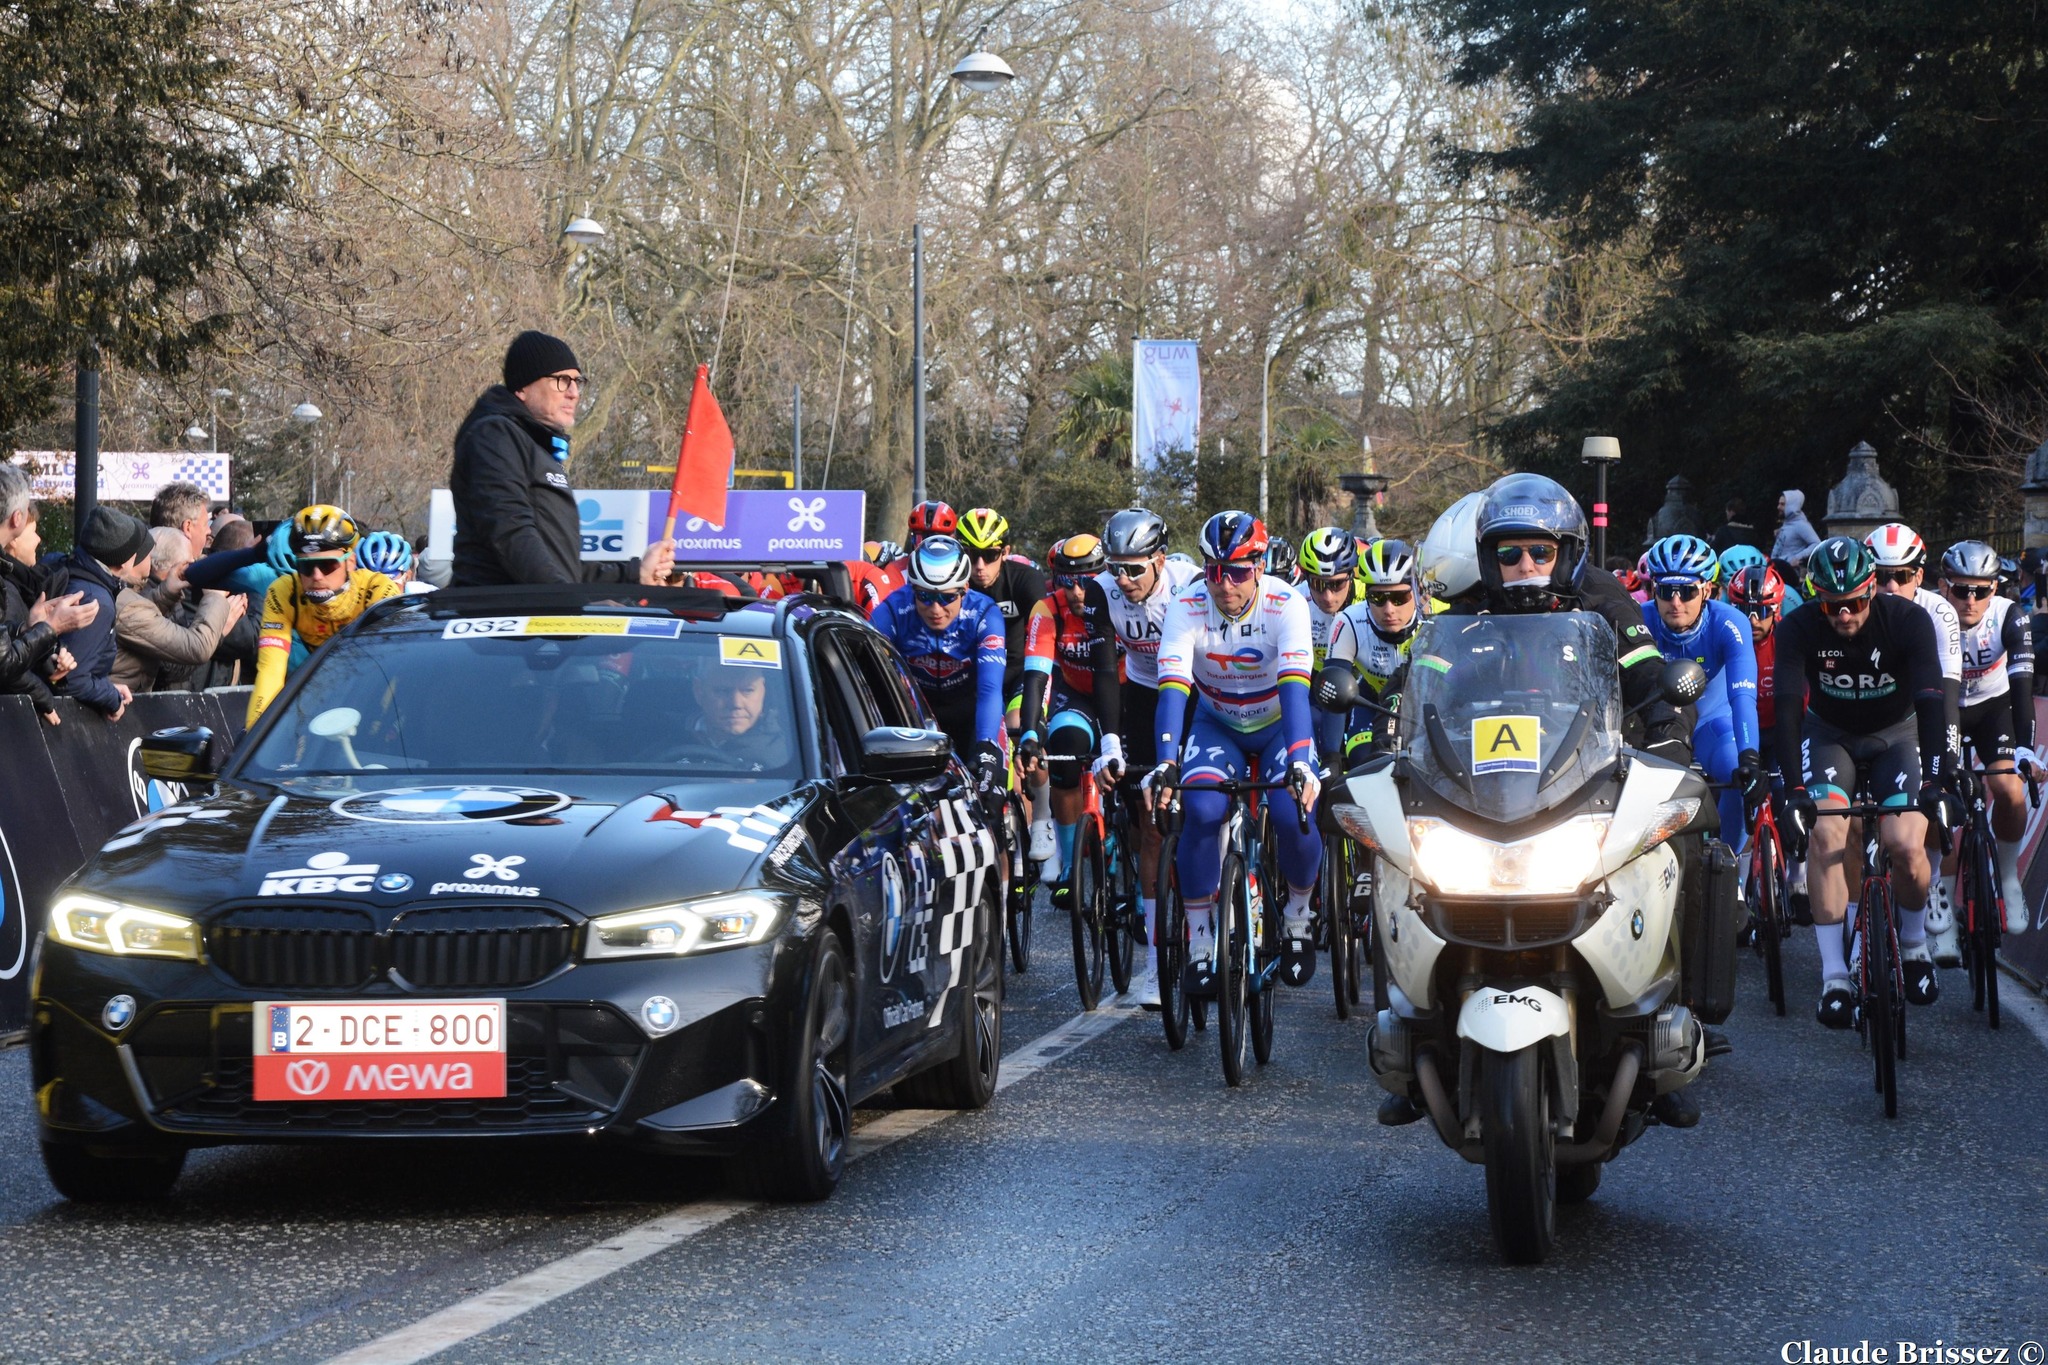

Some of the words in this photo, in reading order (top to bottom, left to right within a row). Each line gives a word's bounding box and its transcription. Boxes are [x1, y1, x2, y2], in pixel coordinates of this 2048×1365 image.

[1504, 507, 1534, 516] SHOEI
[580, 534, 623, 553] BC
[768, 537, 843, 553] proximus
[452, 620, 518, 635] 032
[1028, 612, 1042, 652] MERIDA
[1126, 621, 1162, 640] UA
[1724, 619, 1744, 645] GIANT
[1935, 602, 1960, 656] Cofidis
[737, 642, 764, 657] A
[1962, 647, 1993, 667] AE
[1206, 671, 1268, 680] TotalEnergies
[1818, 671, 1896, 689] BORA
[1225, 705, 1269, 719] VENDÉE
[1490, 723, 1522, 752] A
[1663, 858, 1676, 890] EMG
[257, 875, 377, 897] KBC
[429, 881, 541, 897] proximus
[1493, 994, 1542, 1013] EMG
[273, 1031, 288, 1048] B
[343, 1061, 474, 1091] mewa
